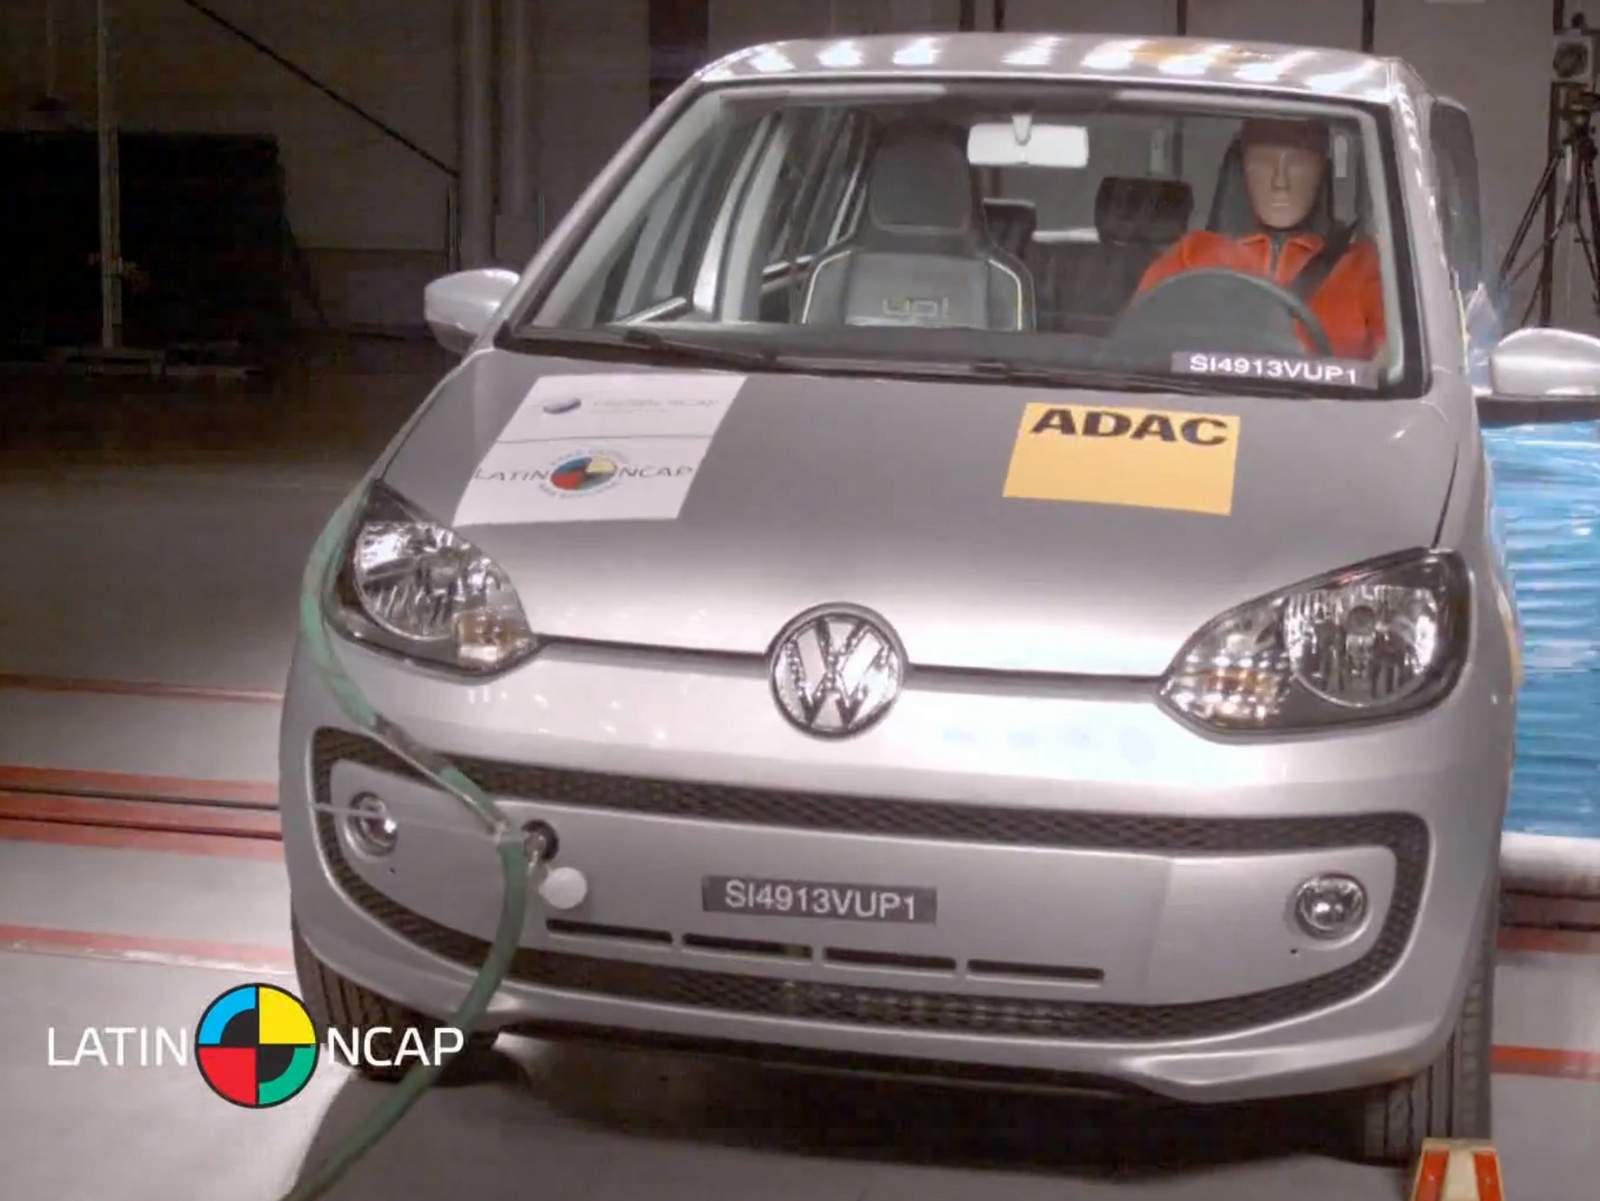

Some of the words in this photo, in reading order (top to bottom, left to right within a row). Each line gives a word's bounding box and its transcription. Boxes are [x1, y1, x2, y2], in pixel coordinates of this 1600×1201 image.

[1189, 355, 1357, 384] SI4913VUP1
[1030, 408, 1228, 447] ADAC
[473, 468, 548, 481] LATIN
[617, 467, 693, 477] NCAP
[725, 879, 915, 920] SI4913VUP1
